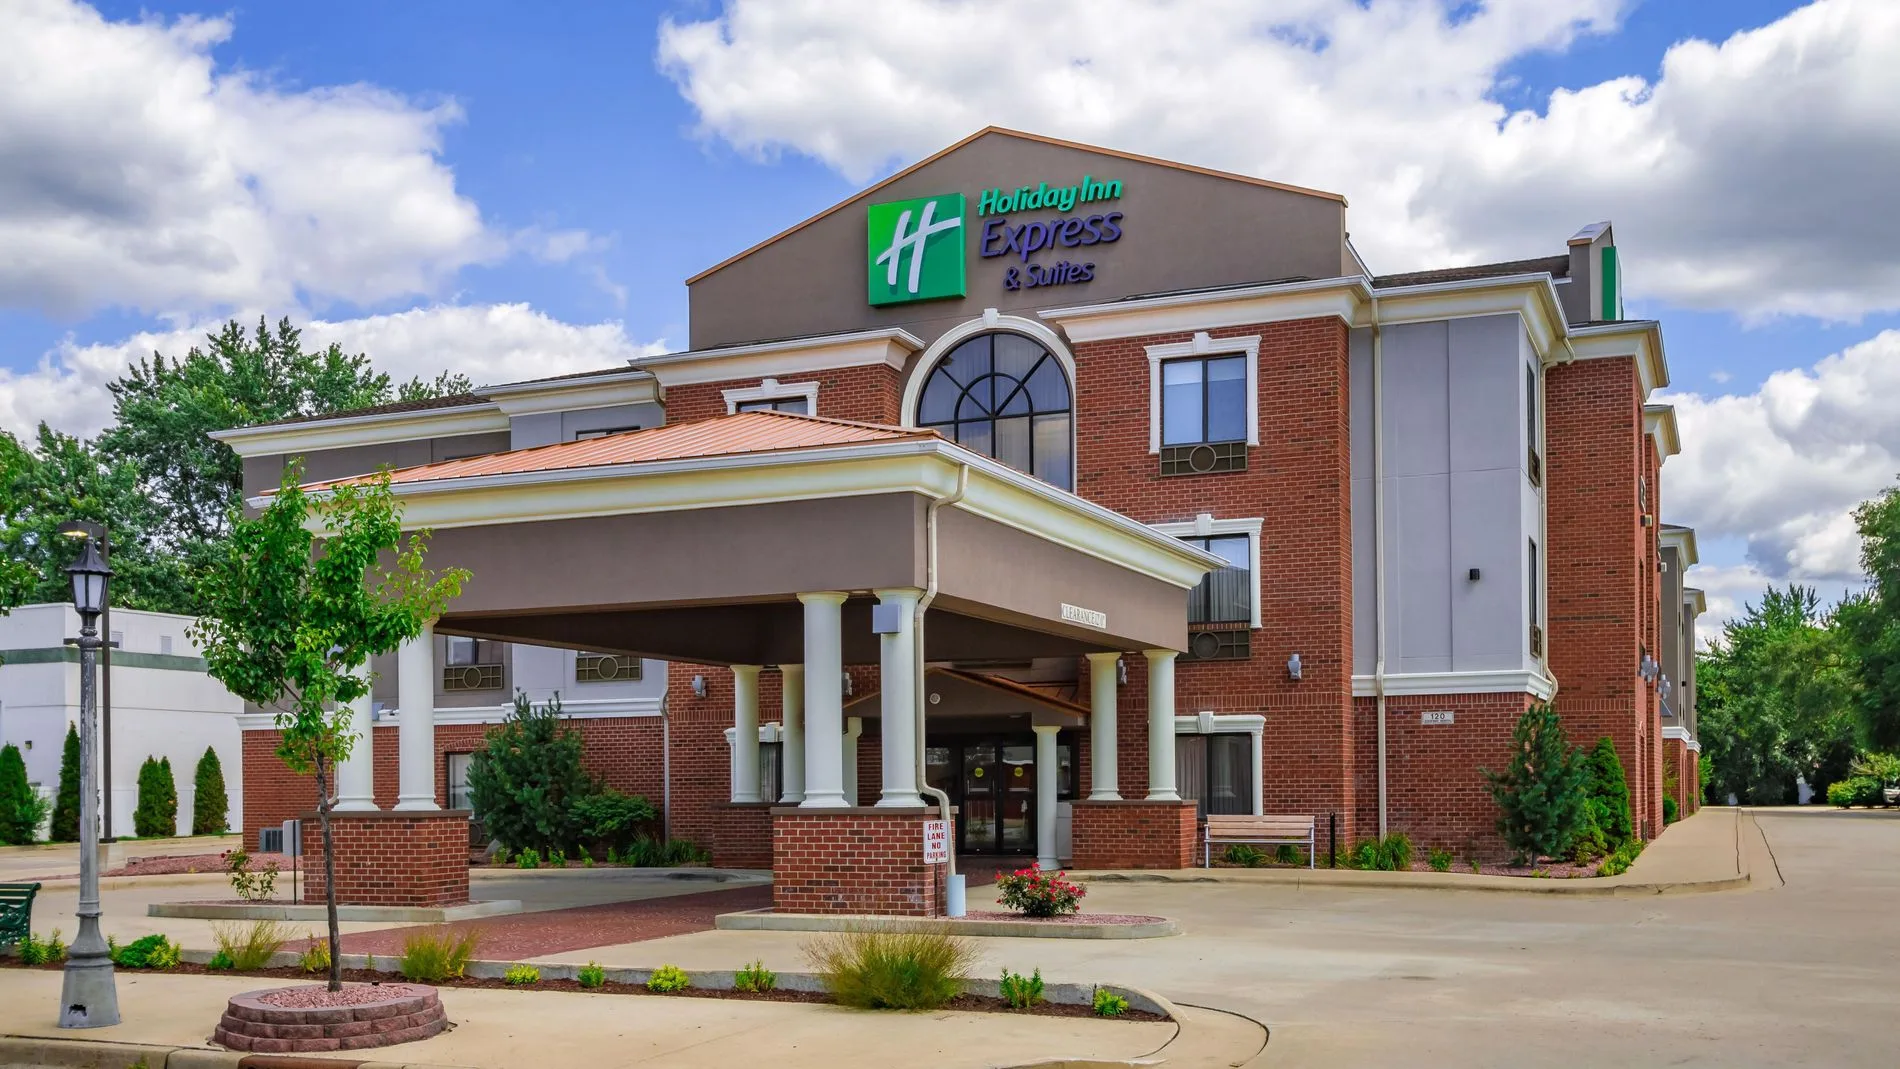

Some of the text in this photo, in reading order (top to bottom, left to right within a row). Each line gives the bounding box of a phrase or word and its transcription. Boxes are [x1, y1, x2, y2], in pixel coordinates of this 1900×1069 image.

[977, 175, 1123, 216] Holiday Inn
[980, 211, 1123, 263] Express
[1003, 260, 1095, 291] & Suites
[1062, 605, 1095, 624] CLEARANCE
[928, 822, 944, 830] FIRE
[927, 832, 945, 840] LANE
[931, 842, 941, 850] NO
[926, 851, 947, 859] PARKING
